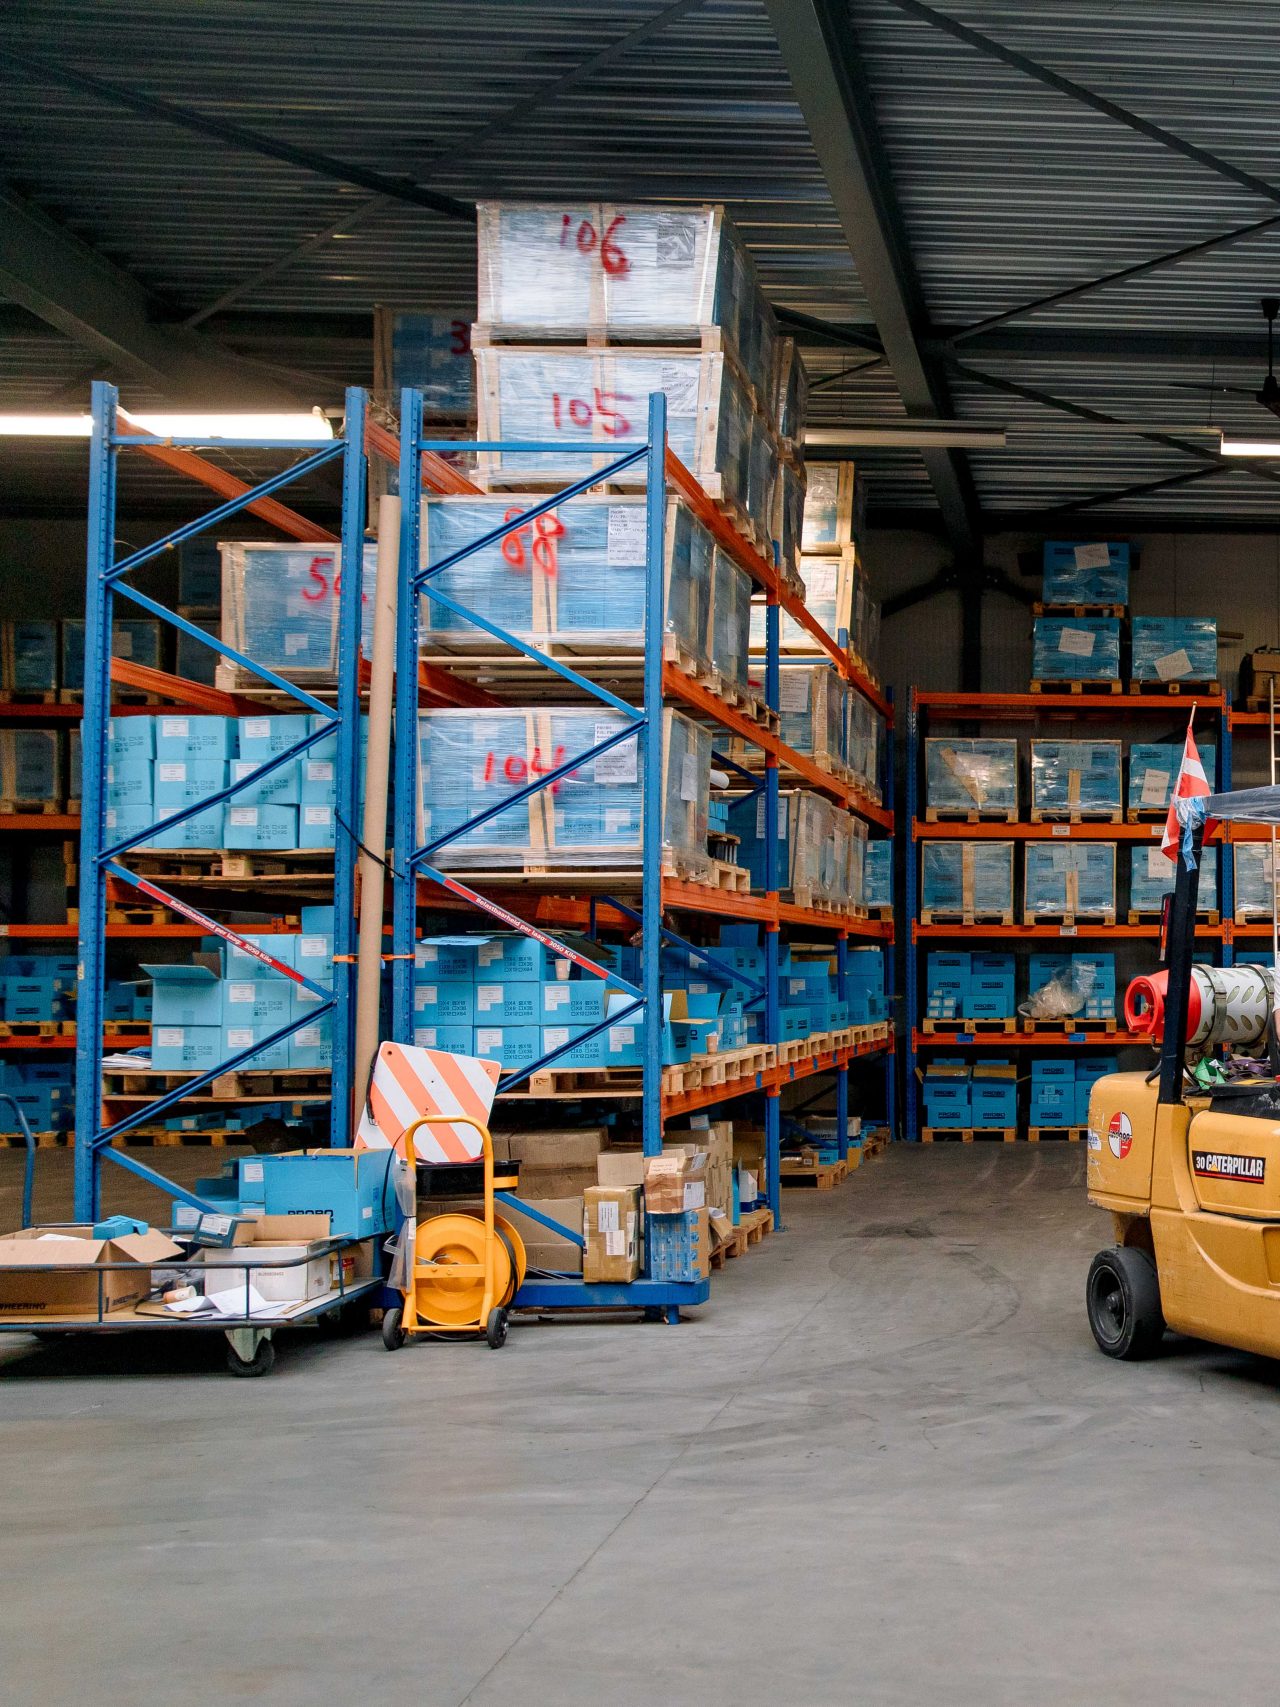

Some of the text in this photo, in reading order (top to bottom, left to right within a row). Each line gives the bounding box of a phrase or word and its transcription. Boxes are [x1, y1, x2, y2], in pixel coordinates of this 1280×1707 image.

[560, 214, 631, 278] 106
[552, 387, 632, 437] 105
[476, 897, 521, 927] Belastbaarheid
[519, 924, 532, 933] per
[531, 931, 548, 943] laag:
[564, 949, 577, 960] Kilo
[259, 952, 273, 964] Kilo
[1195, 1154, 1264, 1178] 30 CATERPILLAR
